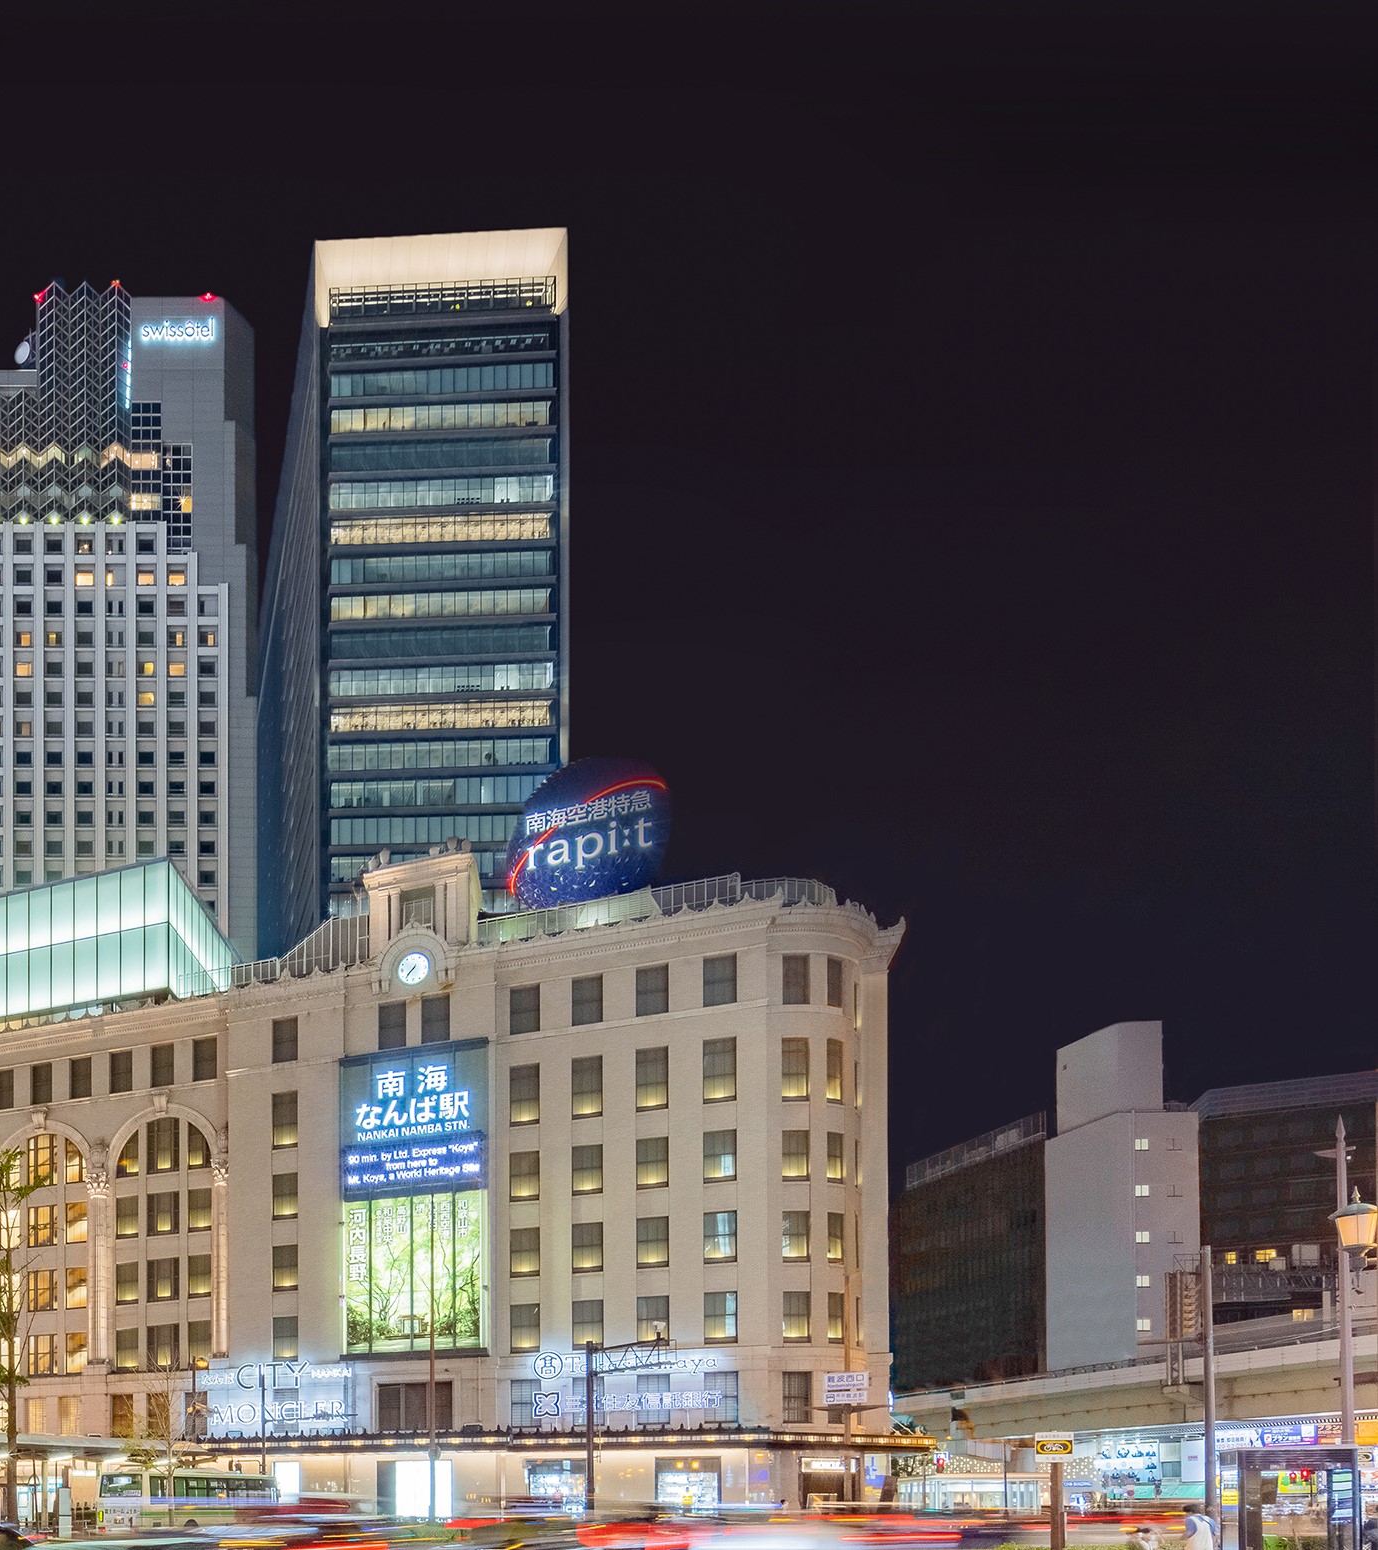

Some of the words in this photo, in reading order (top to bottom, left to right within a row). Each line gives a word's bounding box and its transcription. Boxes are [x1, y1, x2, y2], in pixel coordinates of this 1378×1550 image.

[141, 316, 215, 339] swissôtel
[525, 789, 652, 835] 南海空港特急
[355, 1090, 470, 1130] なんば駅
[357, 1127, 399, 1142] NANKAI
[401, 1122, 442, 1137] NAMBA
[444, 1118, 471, 1132] STN.
[361, 1153, 379, 1163] min.
[381, 1151, 392, 1161] by
[393, 1150, 410, 1160] Ltd.
[412, 1145, 447, 1159] Express
[385, 1161, 405, 1171] from
[407, 1158, 427, 1168] here
[428, 1156, 438, 1166] to
[348, 1175, 361, 1185] Mt.
[388, 1172, 395, 1181] a
[396, 1168, 422, 1180] World
[424, 1164, 461, 1177] Heritage
[462, 1162, 480, 1173] Site
[458, 1199, 467, 1238] 和歌山市
[349, 1209, 367, 1281] 河内長野
[235, 1359, 310, 1390] CITY
[311, 1367, 352, 1379] NANKAI
[210, 1399, 350, 1427] MONCLER
